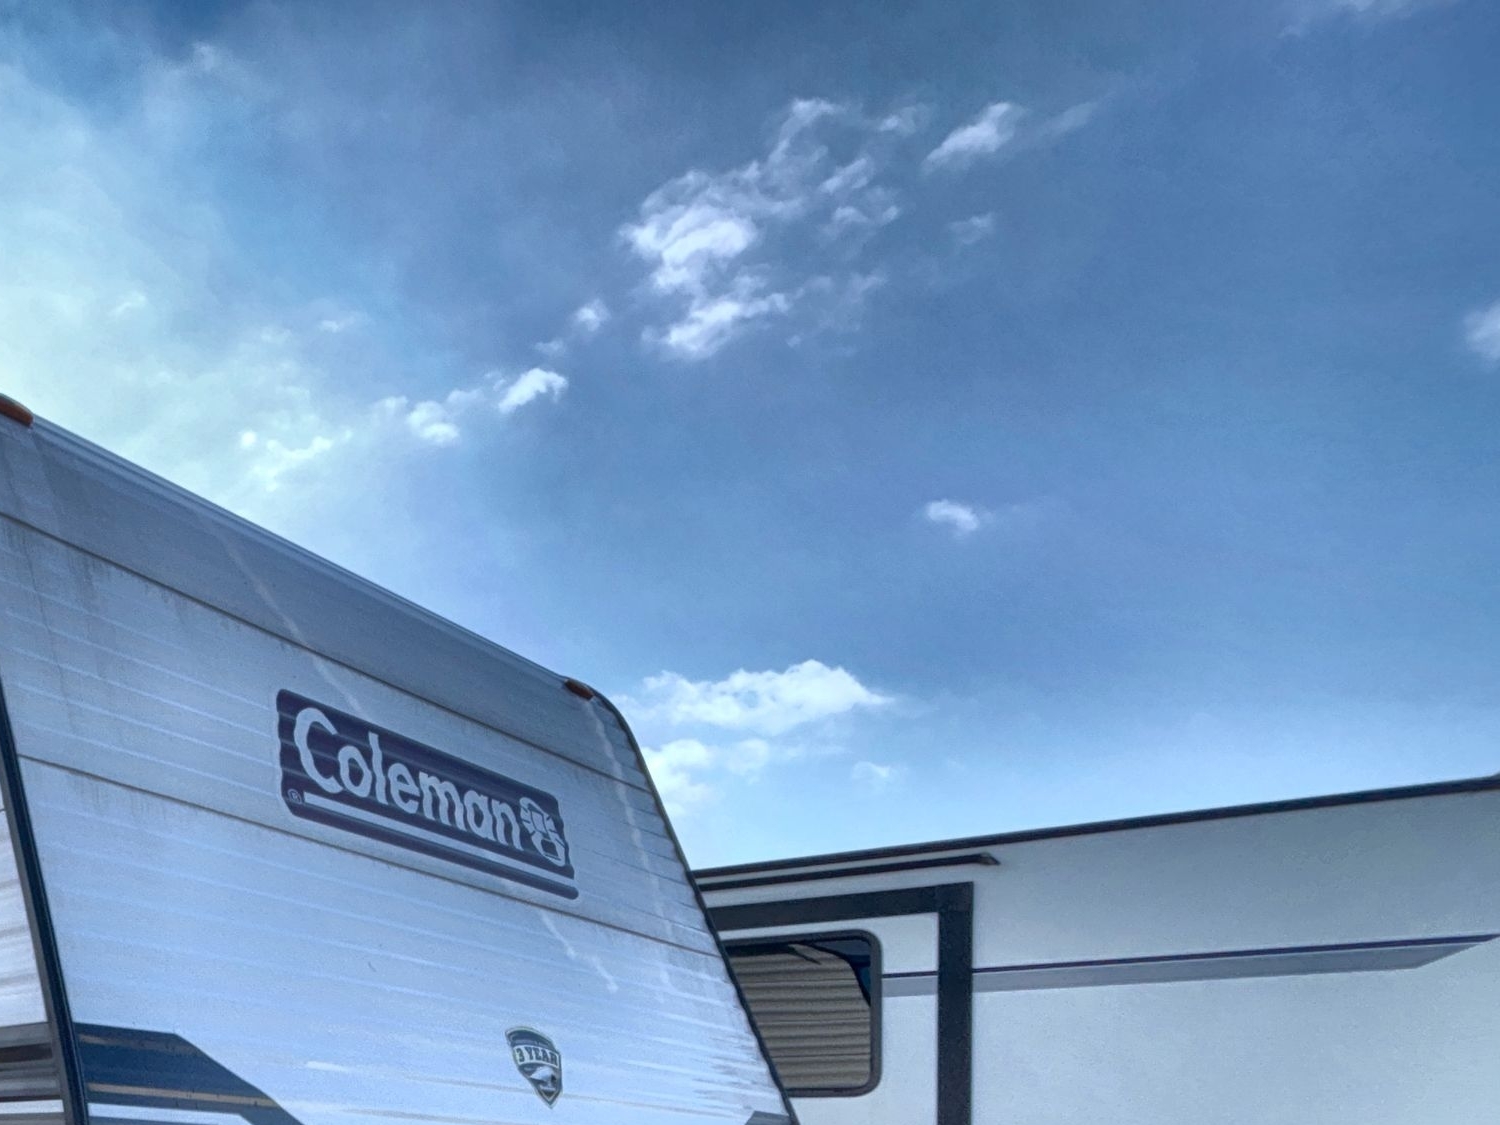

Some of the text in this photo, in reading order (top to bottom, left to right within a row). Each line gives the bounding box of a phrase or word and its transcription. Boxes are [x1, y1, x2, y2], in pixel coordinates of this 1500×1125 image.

[293, 706, 525, 852] Coleman
[515, 1046, 558, 1067] 3 YEAR
